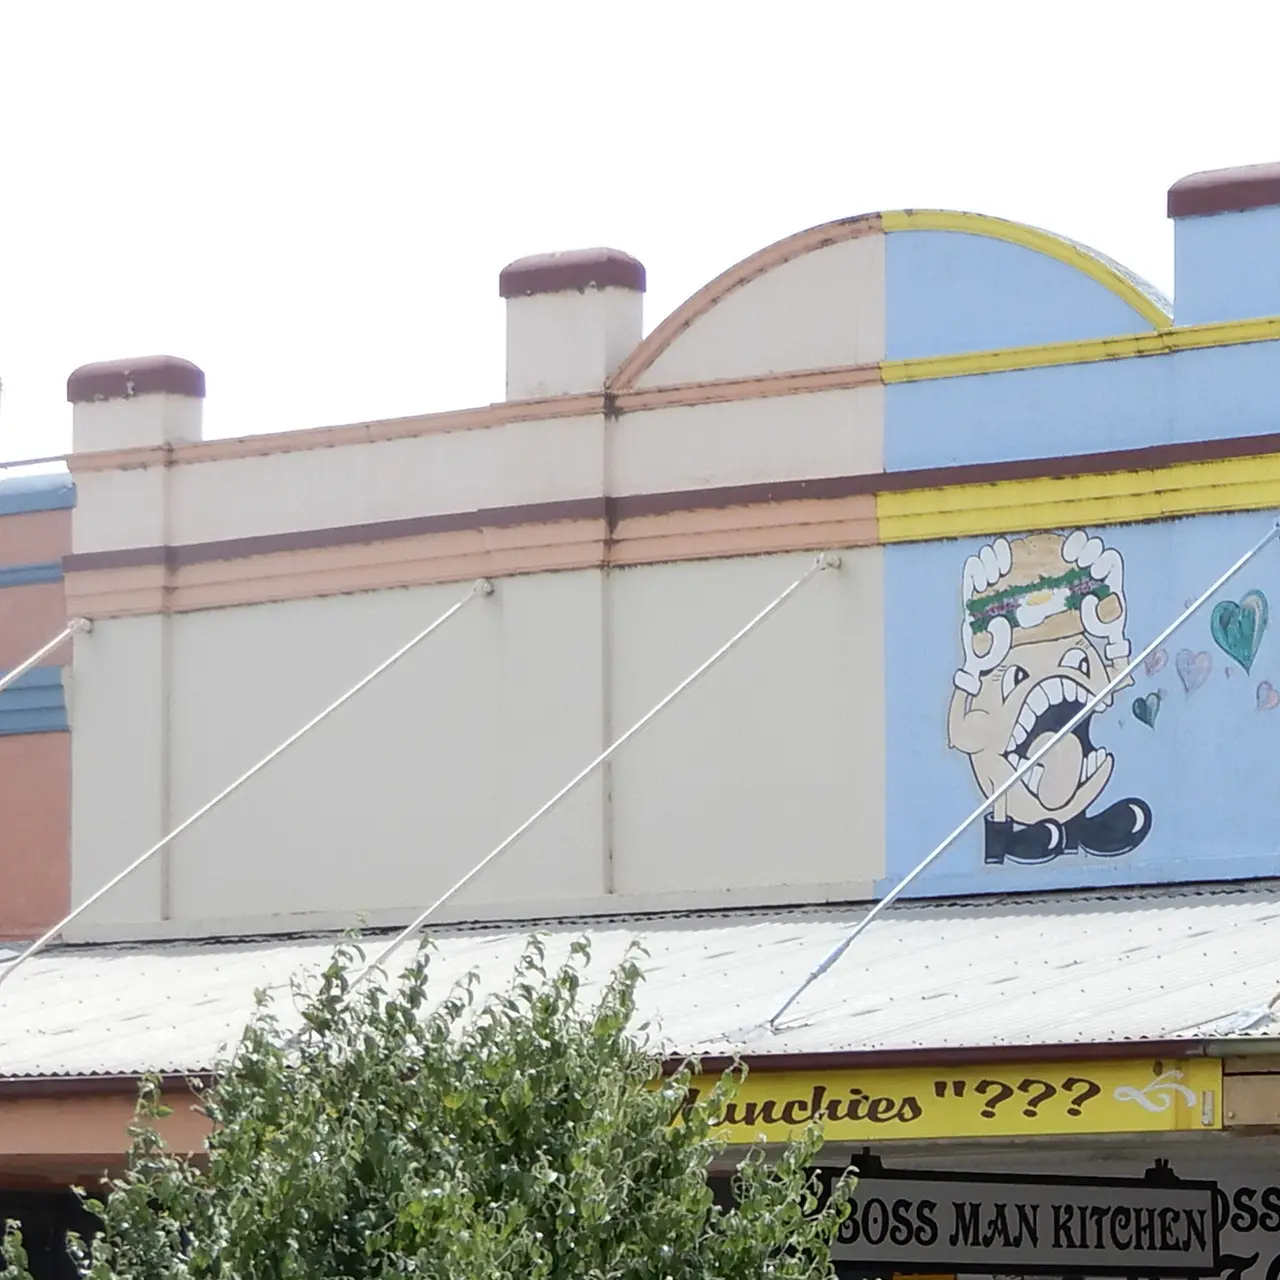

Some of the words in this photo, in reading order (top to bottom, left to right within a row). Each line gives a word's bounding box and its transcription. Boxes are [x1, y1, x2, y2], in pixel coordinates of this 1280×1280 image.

[838, 1196, 938, 1247] BOSS
[949, 1200, 1040, 1249] MAN
[1052, 1203, 1208, 1253] KITCHEN
